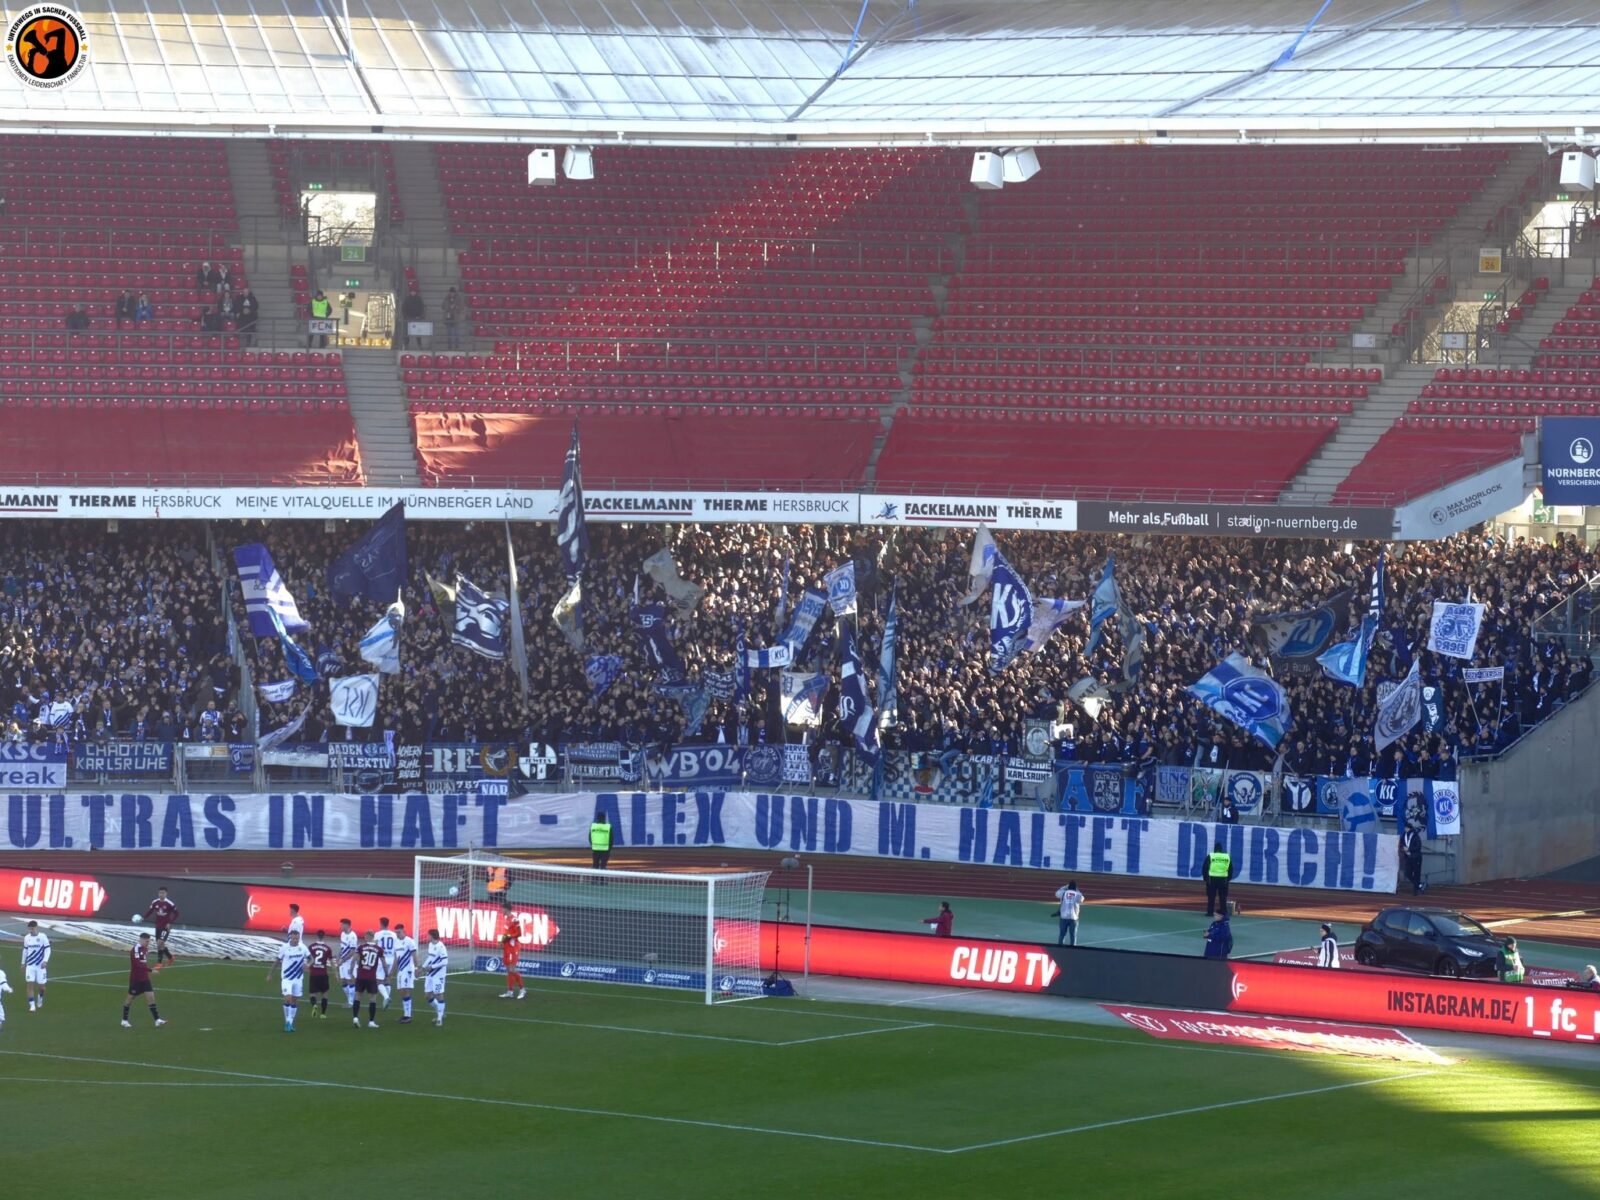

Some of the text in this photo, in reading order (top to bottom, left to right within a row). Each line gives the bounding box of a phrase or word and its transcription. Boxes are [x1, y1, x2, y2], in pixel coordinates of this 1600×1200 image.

[69, 494, 137, 508] THERME
[142, 495, 222, 508] HERSBRUCK
[236, 496, 278, 508] MEINE
[282, 496, 374, 510] VITALQUELLE
[378, 496, 393, 508] IM
[400, 494, 492, 508] NÜRNBERGER
[496, 497, 534, 509] LAND
[584, 497, 849, 513] FACKELMANN THERME HERSBRUCK
[1447, 483, 1503, 513] MAX MORLOCK
[905, 502, 1063, 519] FACKELMANN THERME
[1450, 499, 1482, 518] STADION
[1108, 510, 1358, 533] Mehr als Fußball stadion-nuernberg.de
[0, 741, 48, 761] KSC
[86, 743, 164, 757] CHAOTEN
[328, 743, 363, 756] BADEN
[75, 756, 168, 770] KARLSRUHE
[330, 756, 391, 769] KOLLEKTIV
[969, 755, 994, 764] ACAB
[0, 766, 57, 785] reak
[1380, 784, 1396, 800] KSC
[8, 793, 1378, 890] ULTRAS IN HAFT - ALEX UND M. HALTET DURCH!
[18, 876, 106, 912] CLUB TV
[435, 906, 550, 946] WWW.CN
[380, 936, 394, 950] 10
[314, 950, 324, 965] 2
[361, 951, 378, 967] 30
[950, 946, 1058, 987] CLUB TV
[1387, 990, 1519, 1024] INSTAGRAM.DE/
